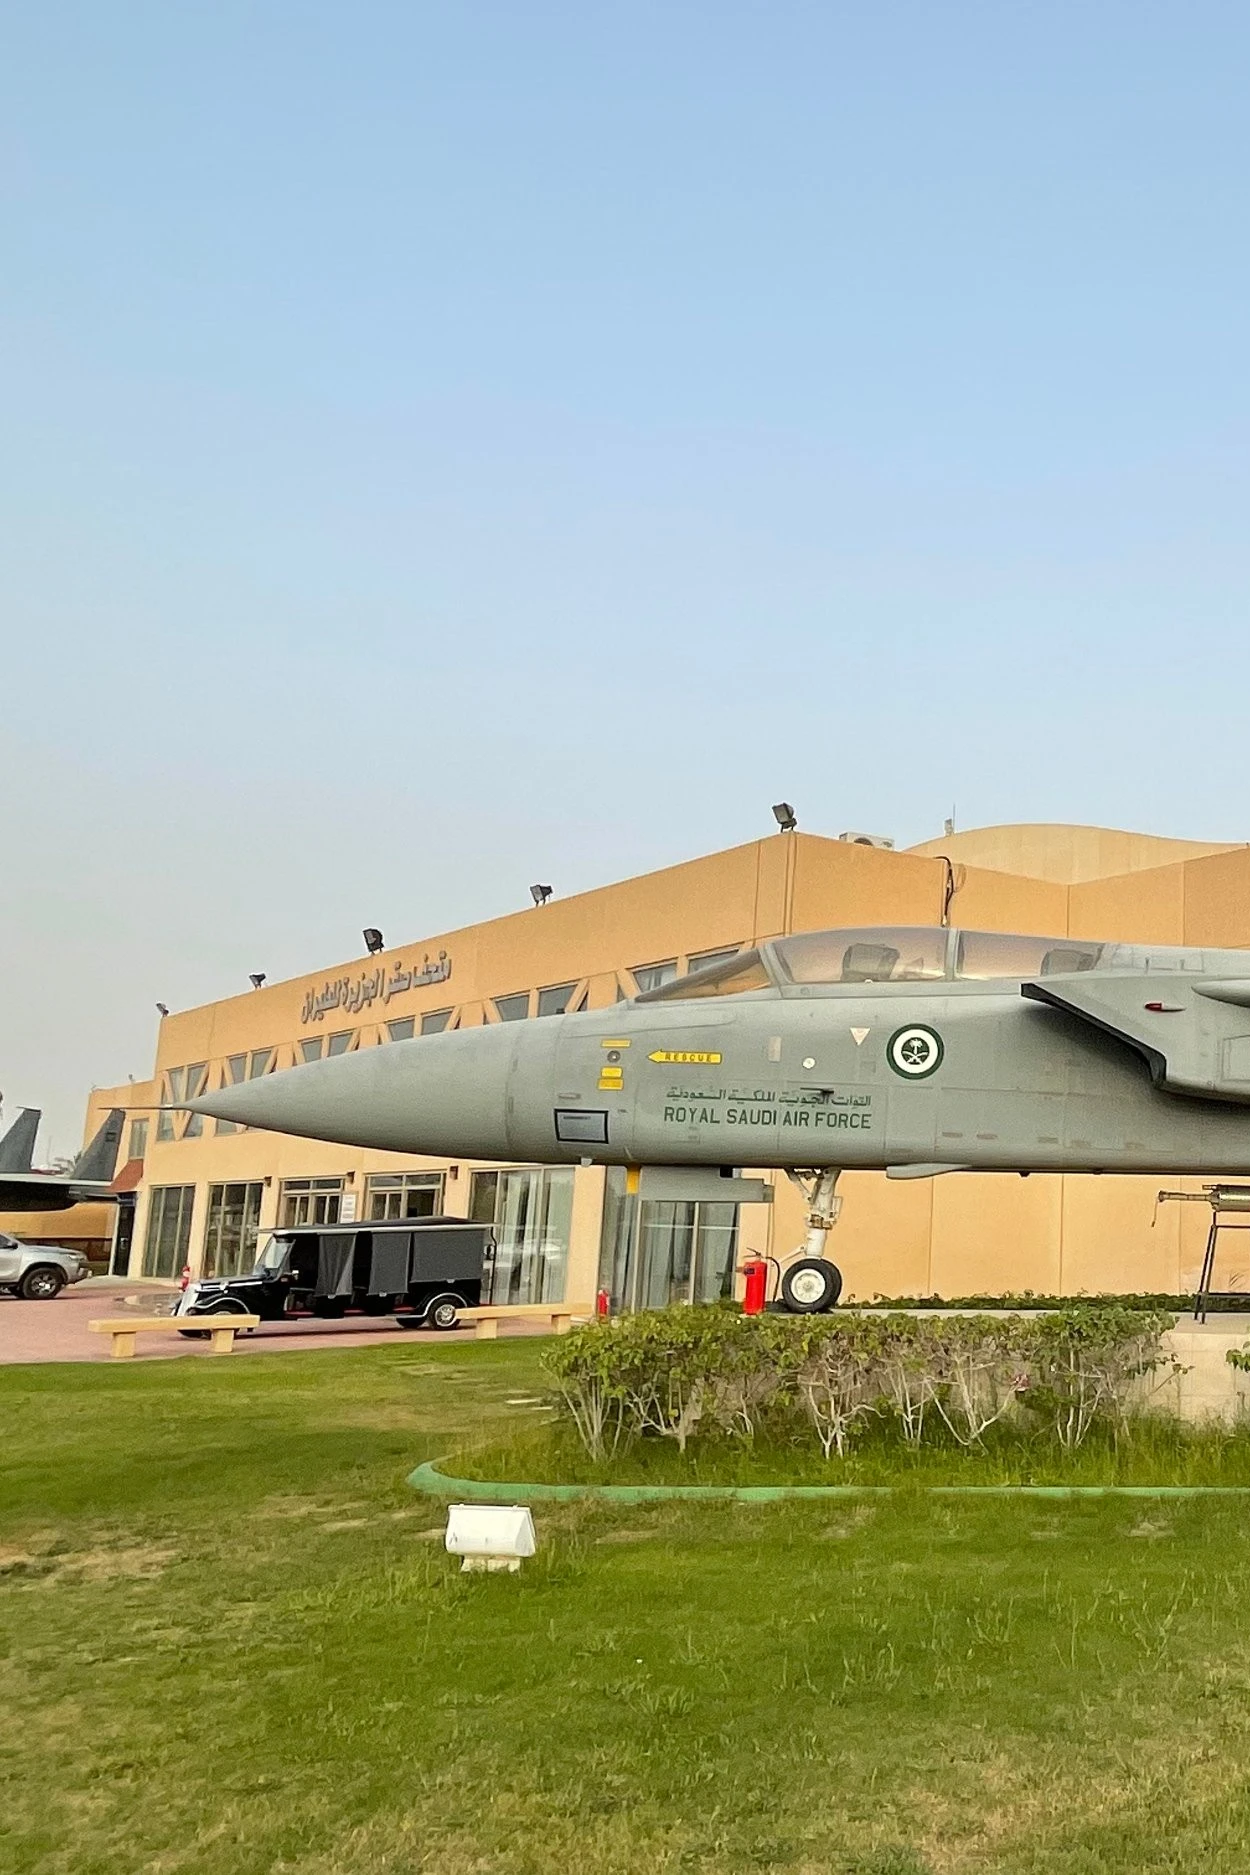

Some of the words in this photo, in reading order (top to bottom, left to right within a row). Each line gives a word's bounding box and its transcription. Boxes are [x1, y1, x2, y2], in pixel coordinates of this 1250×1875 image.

[340, 967, 386, 1014] الجزيرة
[383, 961, 412, 1005] صقر
[301, 978, 343, 1025] للطيران
[664, 1053, 713, 1063] RESCUE
[666, 1086, 727, 1101] السعودية
[728, 1088, 776, 1104] الملكية
[831, 1093, 872, 1108] القوات
[663, 1106, 721, 1125] ROYAL
[726, 1108, 777, 1127] SAUDI
[782, 1112, 810, 1127] AIR
[814, 1112, 873, 1130] FORCE
